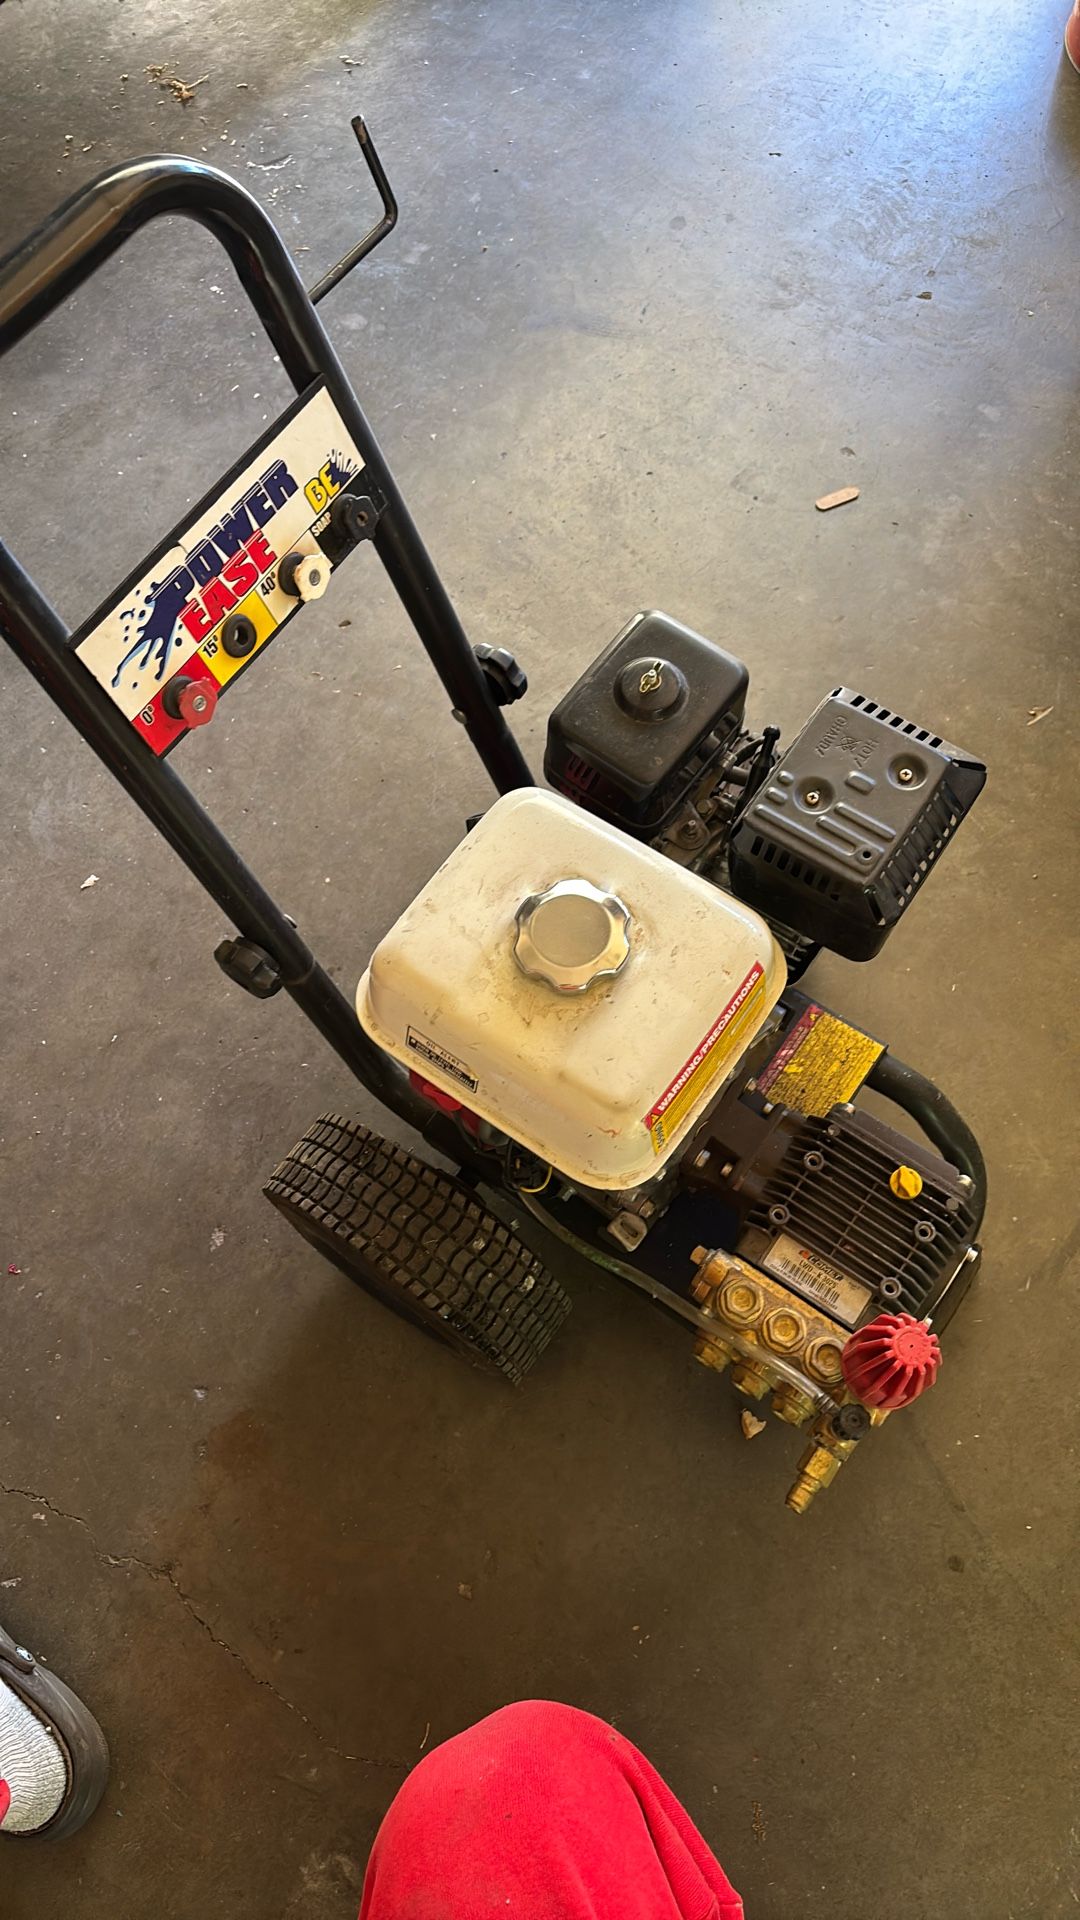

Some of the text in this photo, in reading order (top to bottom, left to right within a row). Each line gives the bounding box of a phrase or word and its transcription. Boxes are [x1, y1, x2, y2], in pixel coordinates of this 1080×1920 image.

[304, 458, 341, 515] BE
[147, 459, 299, 612] POWER
[311, 511, 332, 537] SOAP
[177, 528, 277, 643] EASE
[260, 571, 276, 597] 40°
[202, 635, 219, 659] 15°
[657, 970, 760, 1112] WARNING/PRECAUTIONS
